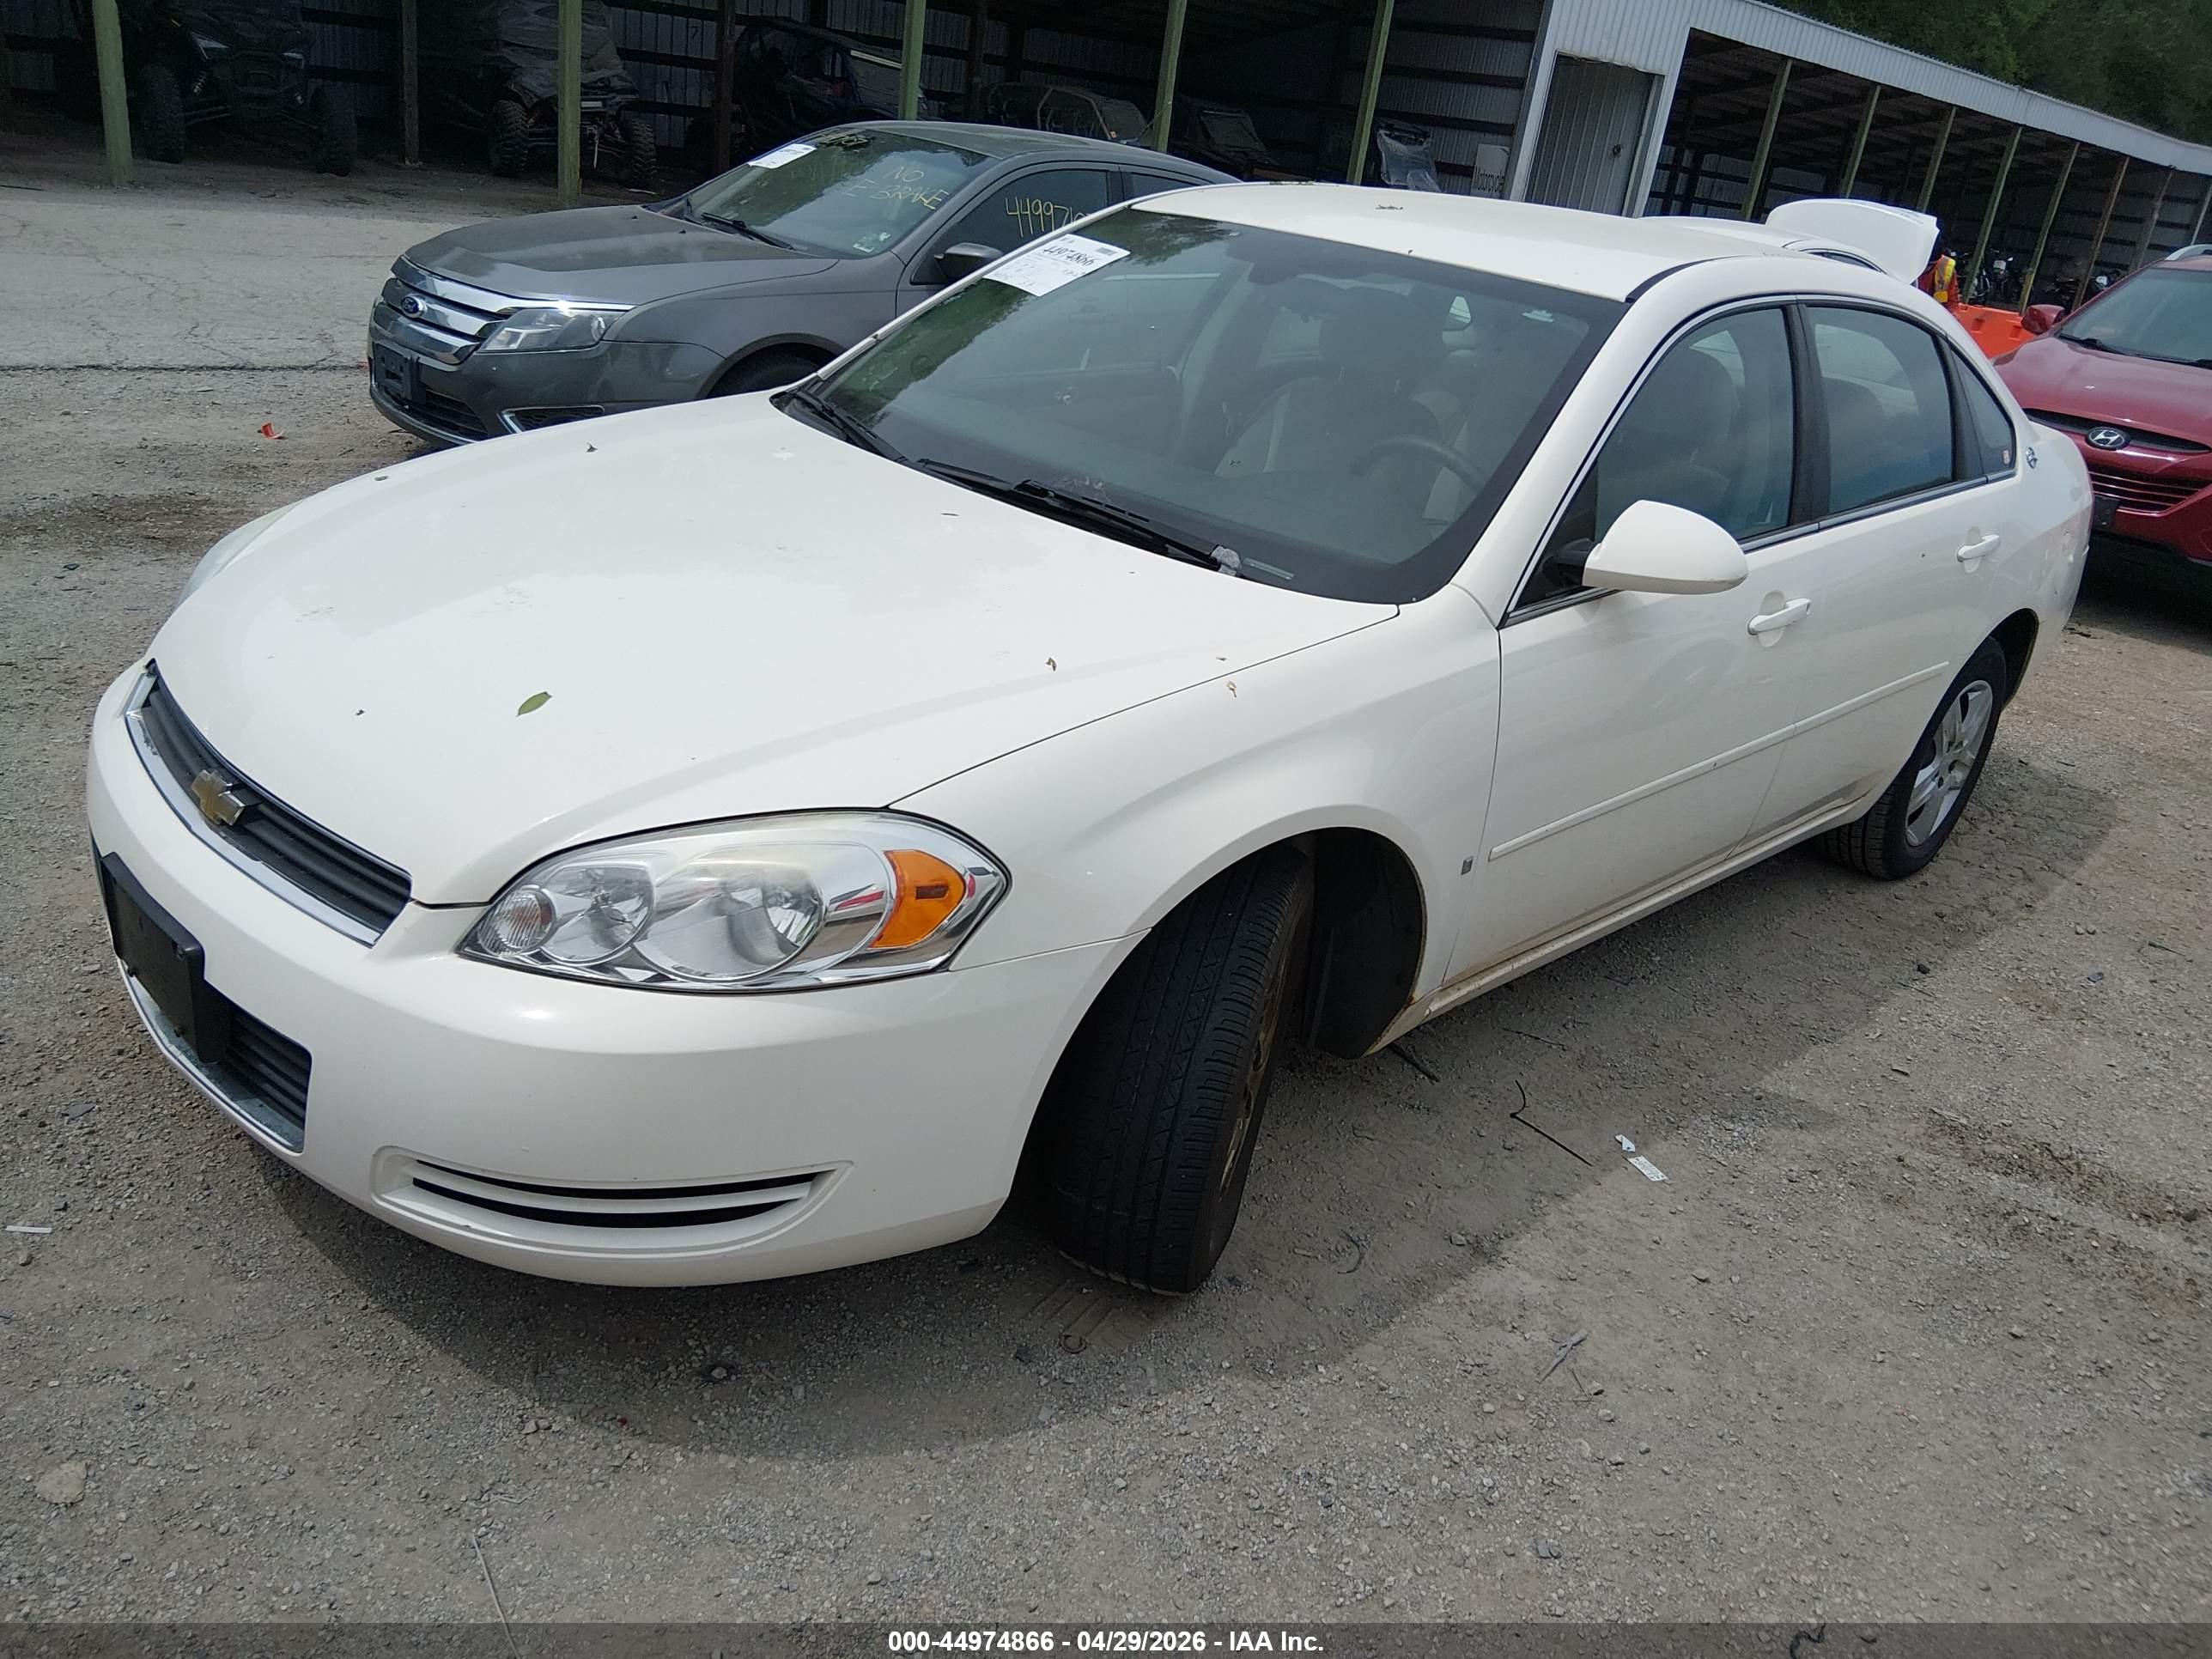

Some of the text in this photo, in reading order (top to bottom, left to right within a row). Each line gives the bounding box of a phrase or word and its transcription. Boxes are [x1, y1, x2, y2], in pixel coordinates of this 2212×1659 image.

[884, 166, 924, 183] NO
[841, 178, 951, 210] E BRAKE
